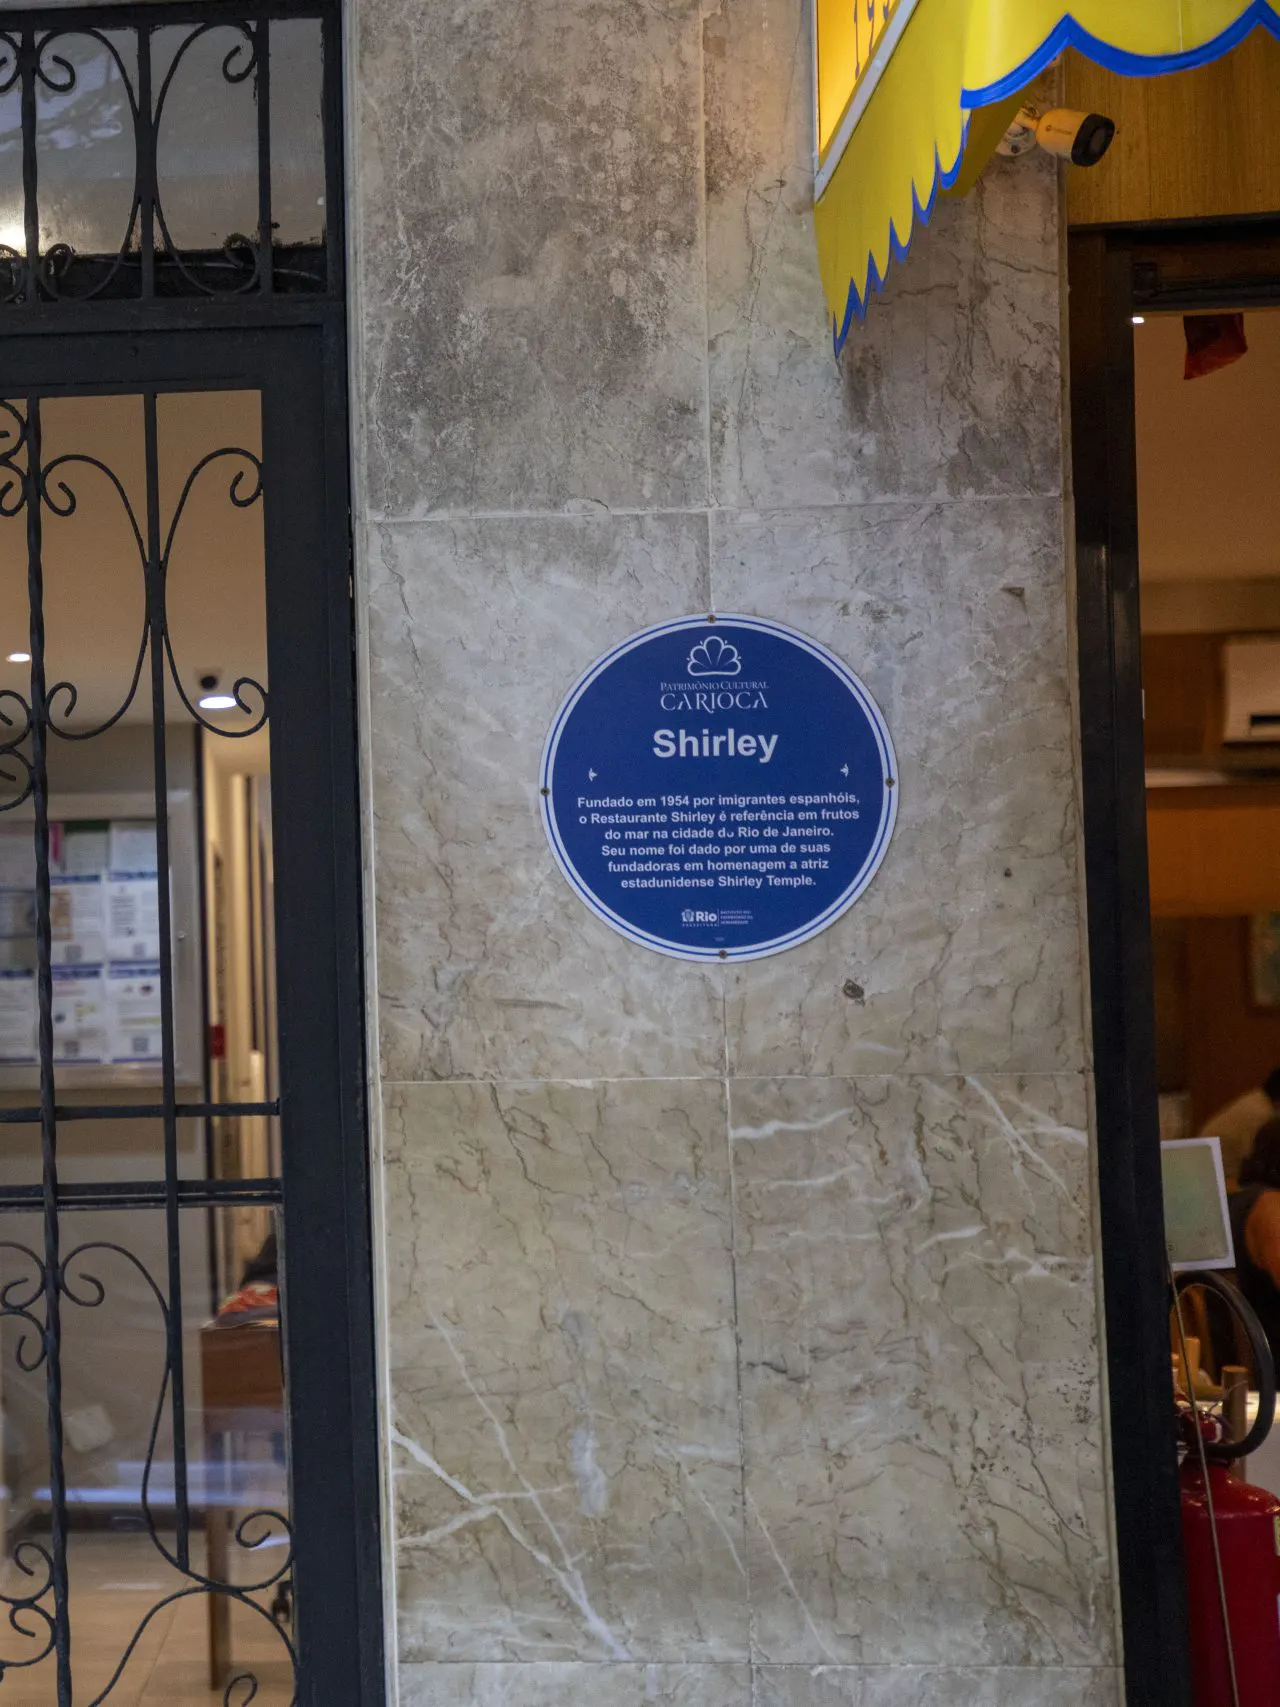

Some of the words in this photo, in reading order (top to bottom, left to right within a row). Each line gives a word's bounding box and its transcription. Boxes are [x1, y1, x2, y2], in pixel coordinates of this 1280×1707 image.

[660, 681, 720, 692] PATRIMÔNIO
[720, 680, 770, 690] CULTURAL
[660, 691, 769, 714] CARIOCA
[653, 728, 779, 763] Shirley
[577, 796, 634, 808] Fundado
[637, 798, 656, 807] em
[661, 795, 690, 807] 1954
[693, 797, 715, 808] por
[718, 794, 786, 808] imigrantes
[789, 792, 860, 806] espanhóis,
[579, 815, 587, 824] o
[591, 813, 668, 824] Restaurante
[671, 811, 716, 824] Shirley
[719, 811, 727, 821] é
[730, 809, 795, 821] referência
[798, 811, 817, 820] em
[821, 808, 860, 820] frutos
[605, 828, 621, 840] do
[624, 830, 649, 840] mar
[653, 830, 668, 839] na
[672, 827, 715, 839] cidade
[738, 826, 760, 838] Rio
[763, 826, 779, 837] de
[782, 825, 835, 837] Janeiro.
[601, 845, 626, 856] Seu
[629, 846, 665, 856] nome
[668, 844, 685, 855] foi
[688, 843, 721, 855] dado
[724, 845, 746, 856] por
[749, 844, 777, 854] uma
[780, 842, 797, 853] de
[800, 843, 831, 853] suas
[608, 861, 680, 872] fundadoras
[684, 862, 704, 871] em
[707, 860, 786, 872] homenagem
[789, 860, 798, 870] a
[801, 858, 830, 869] atriz
[621, 877, 715, 889] estadunidense
[718, 875, 763, 889] Shirley
[766, 874, 817, 888] Temple.
[695, 911, 718, 922] Rio
